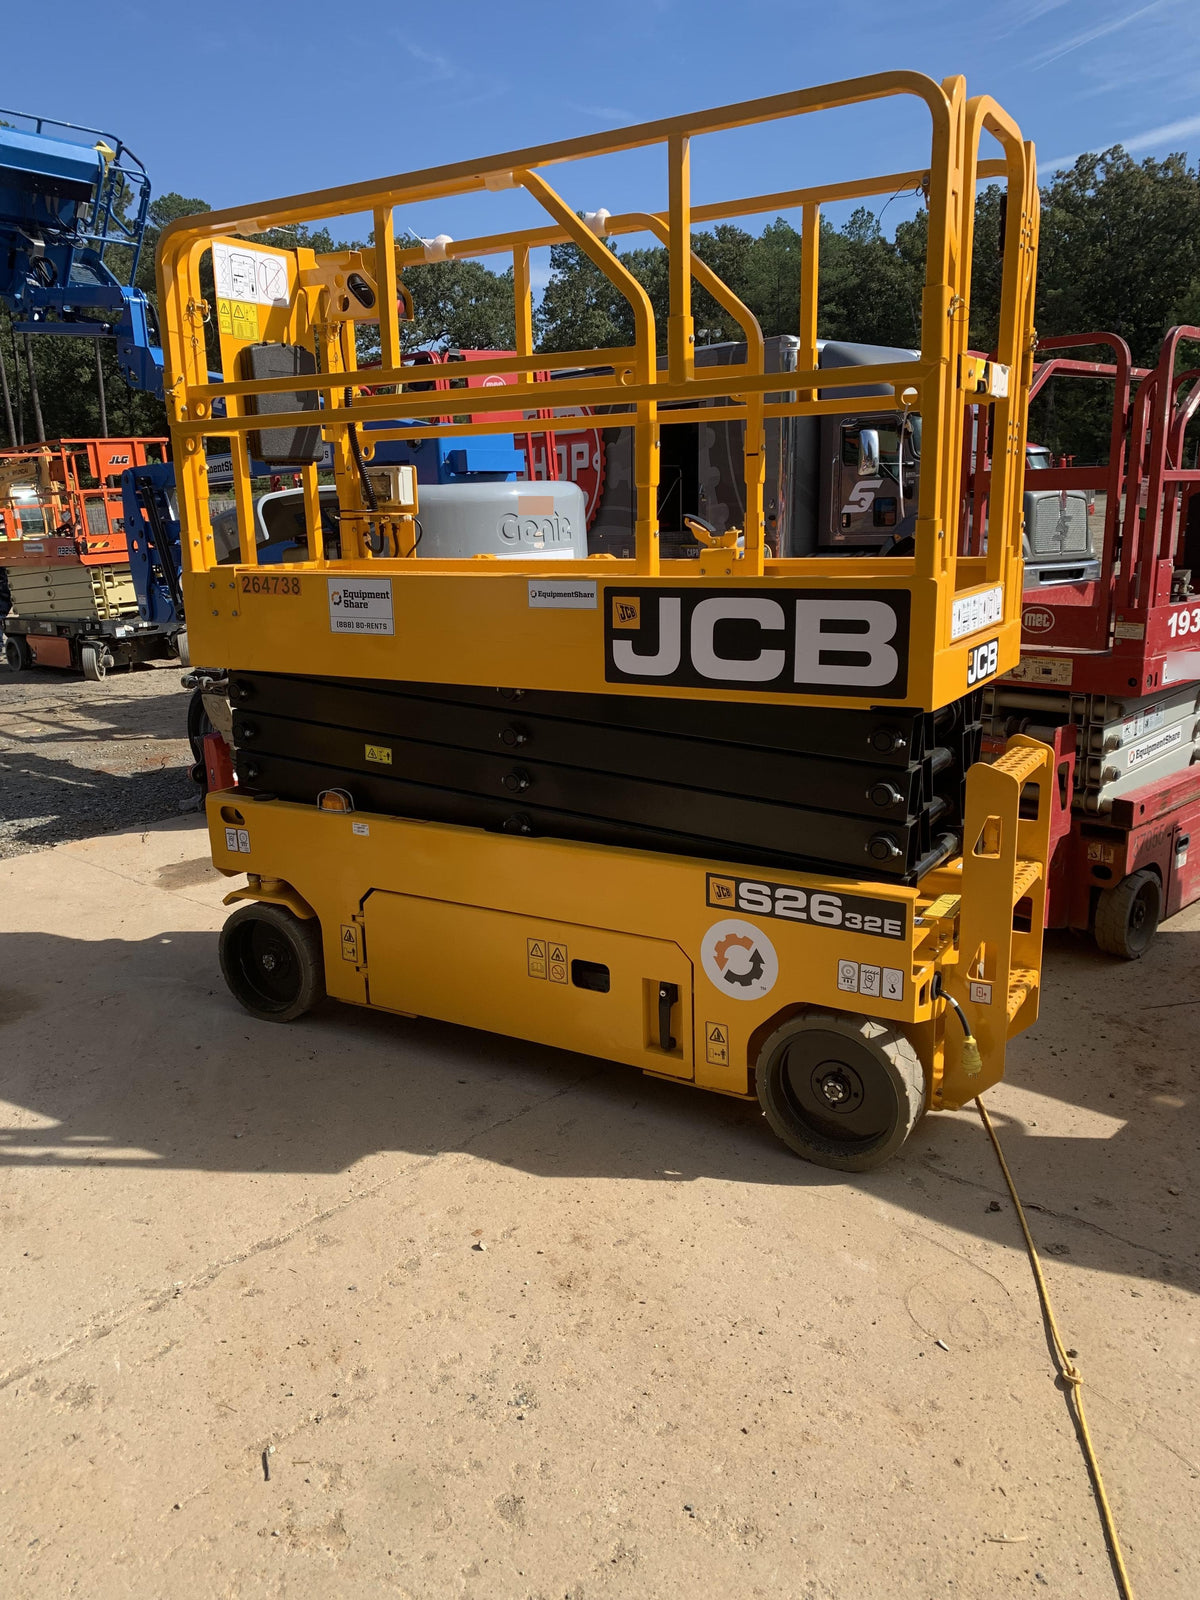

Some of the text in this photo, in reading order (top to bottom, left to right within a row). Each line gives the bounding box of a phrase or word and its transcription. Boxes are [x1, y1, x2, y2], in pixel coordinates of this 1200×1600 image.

[108, 455, 129, 464] JLG
[242, 576, 300, 595] 264738
[343, 589, 390, 600] Equipment
[538, 590, 595, 599] EquipmentShare
[344, 599, 369, 608] Share
[619, 605, 636, 620] JCB
[336, 620, 387, 630] (888) 80-RENTS
[1024, 613, 1050, 627] mec
[1167, 609, 1200, 638] 193
[613, 597, 898, 687] JCB
[968, 641, 998, 684] JCB
[1135, 731, 1180, 760] EquipmentShare
[716, 884, 731, 898] JCB
[738, 882, 902, 937] S26 32E
